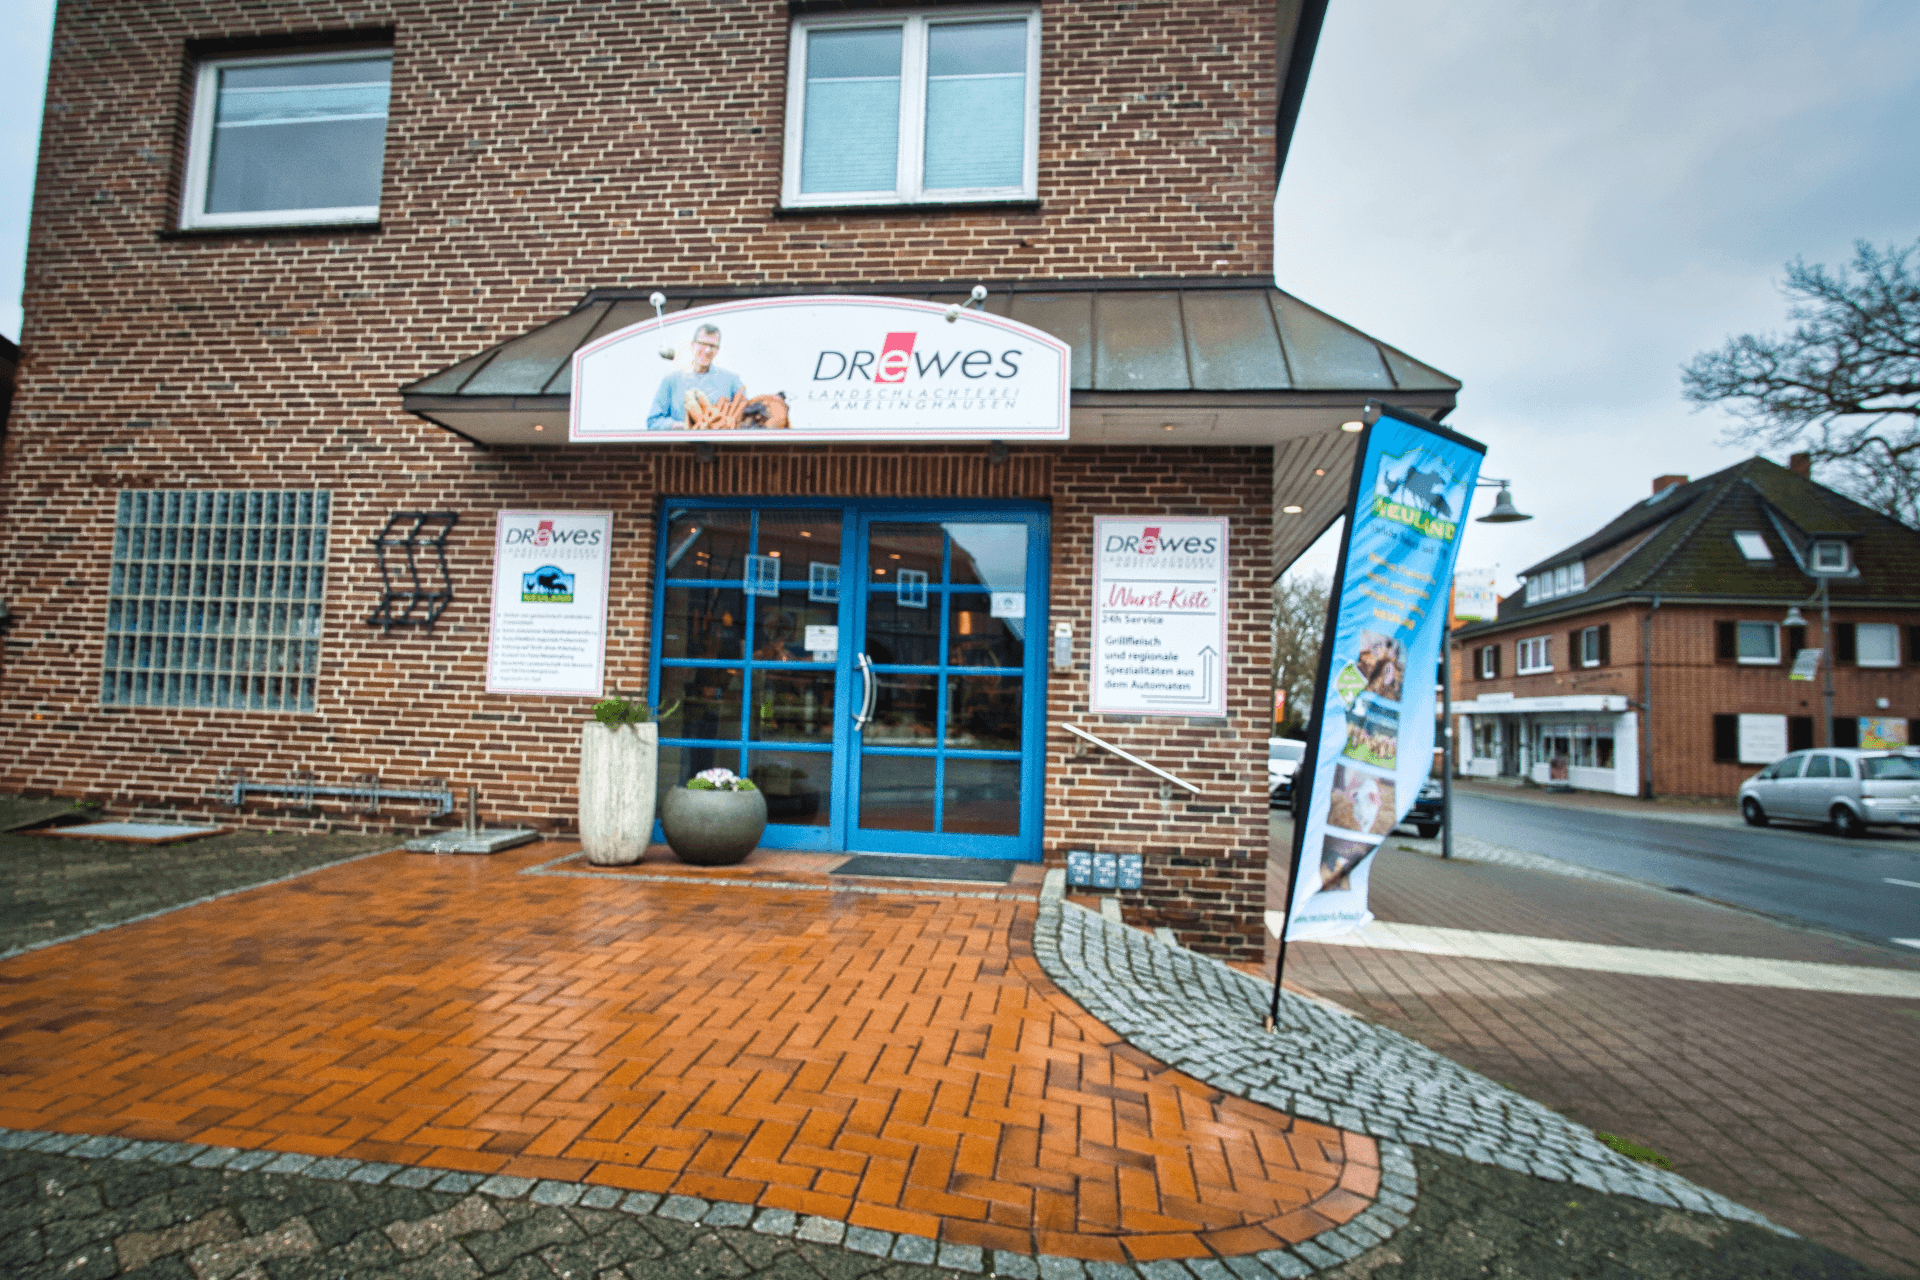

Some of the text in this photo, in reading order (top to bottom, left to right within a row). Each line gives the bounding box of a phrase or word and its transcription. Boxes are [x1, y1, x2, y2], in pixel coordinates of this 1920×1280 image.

[830, 399, 1018, 411] AMELINGHAUSEN
[1102, 614, 1164, 626] 24h Service
[1104, 635, 1162, 647] Grillfleisch
[1104, 650, 1179, 663] und regionale
[1104, 664, 1196, 677] Spezialitäten aus
[1104, 679, 1192, 691] dem Automaten
